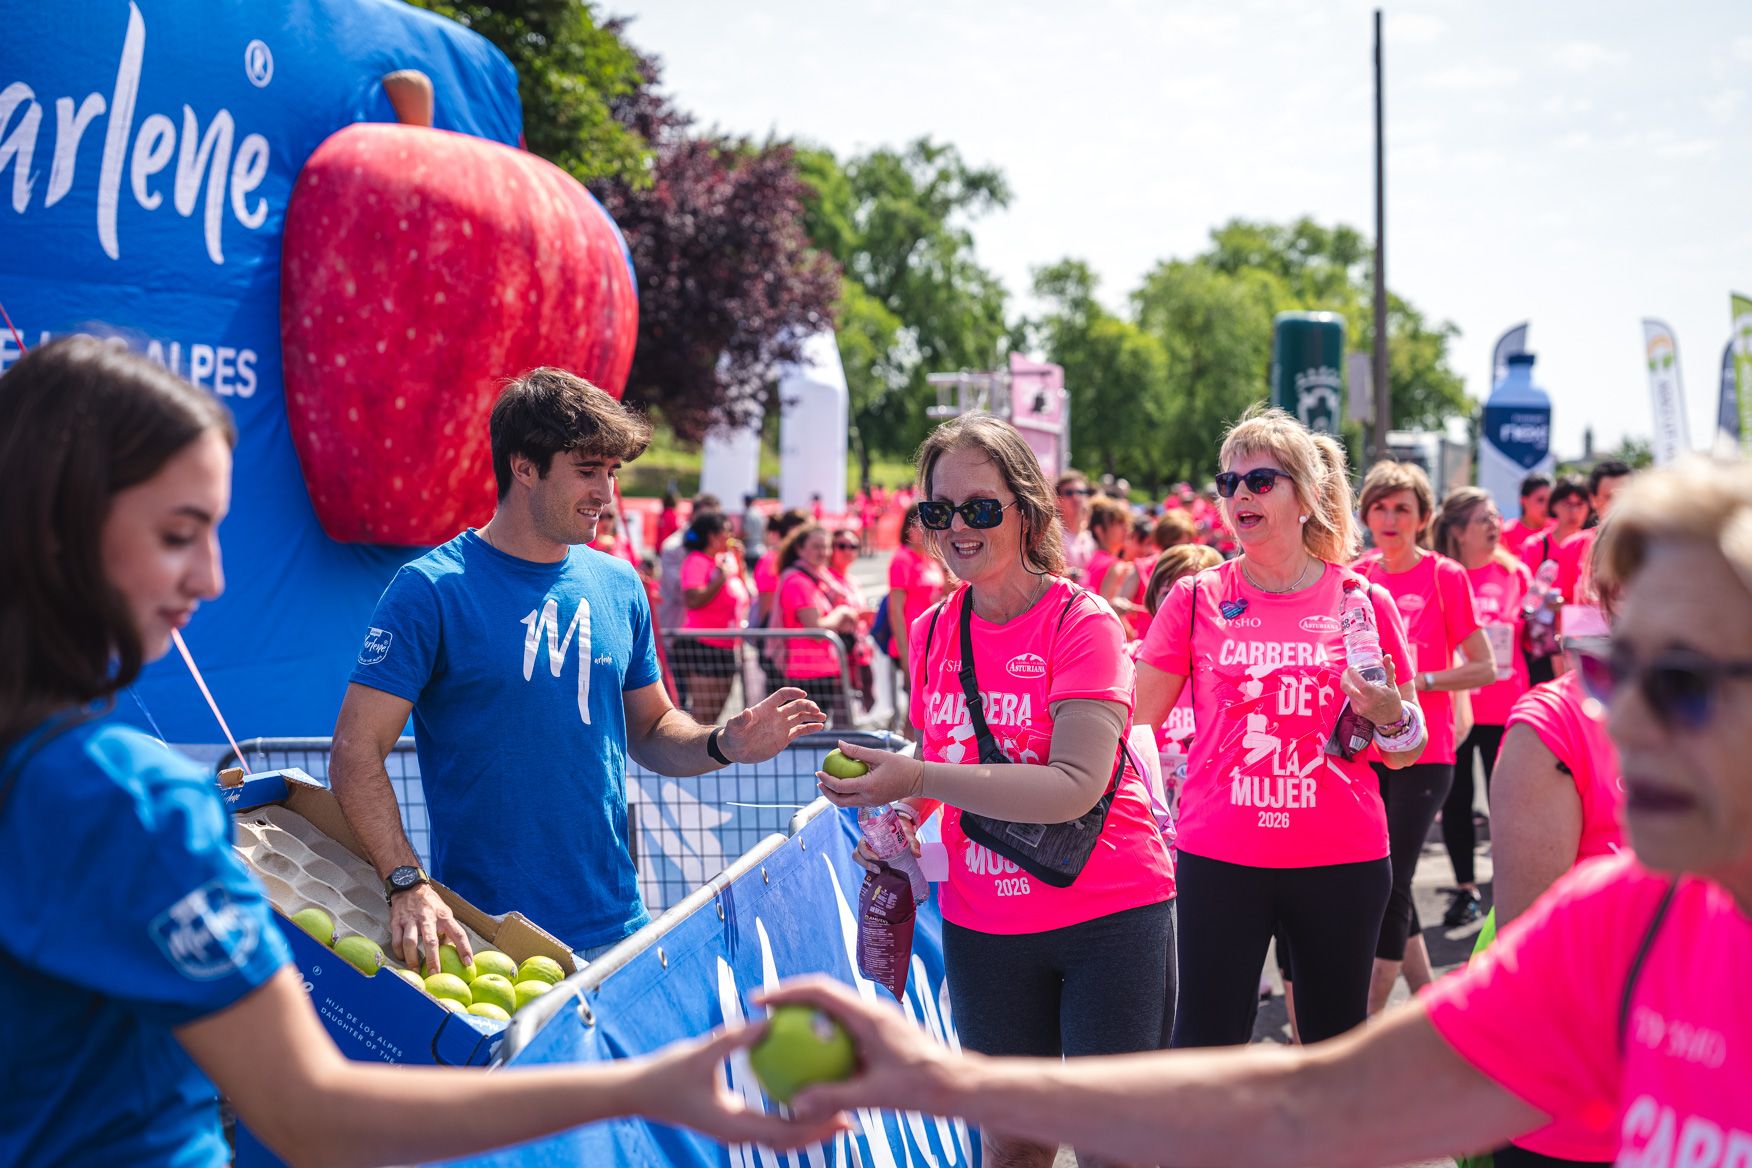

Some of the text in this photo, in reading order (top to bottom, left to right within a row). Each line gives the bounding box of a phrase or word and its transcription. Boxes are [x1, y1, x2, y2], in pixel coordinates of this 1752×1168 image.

[1219, 639, 1329, 667] CARRERA
[929, 691, 1032, 727] CARERA
[1278, 675, 1314, 716] DE
[1272, 737, 1300, 776] LA
[1230, 768, 1317, 809] MUJER
[1257, 811, 1290, 828] 2026
[995, 876, 1031, 896] 2026
[320, 1007, 396, 1065] DAUGHTER OF THE
[325, 997, 403, 1057] HIJA DE LOS ALPES
